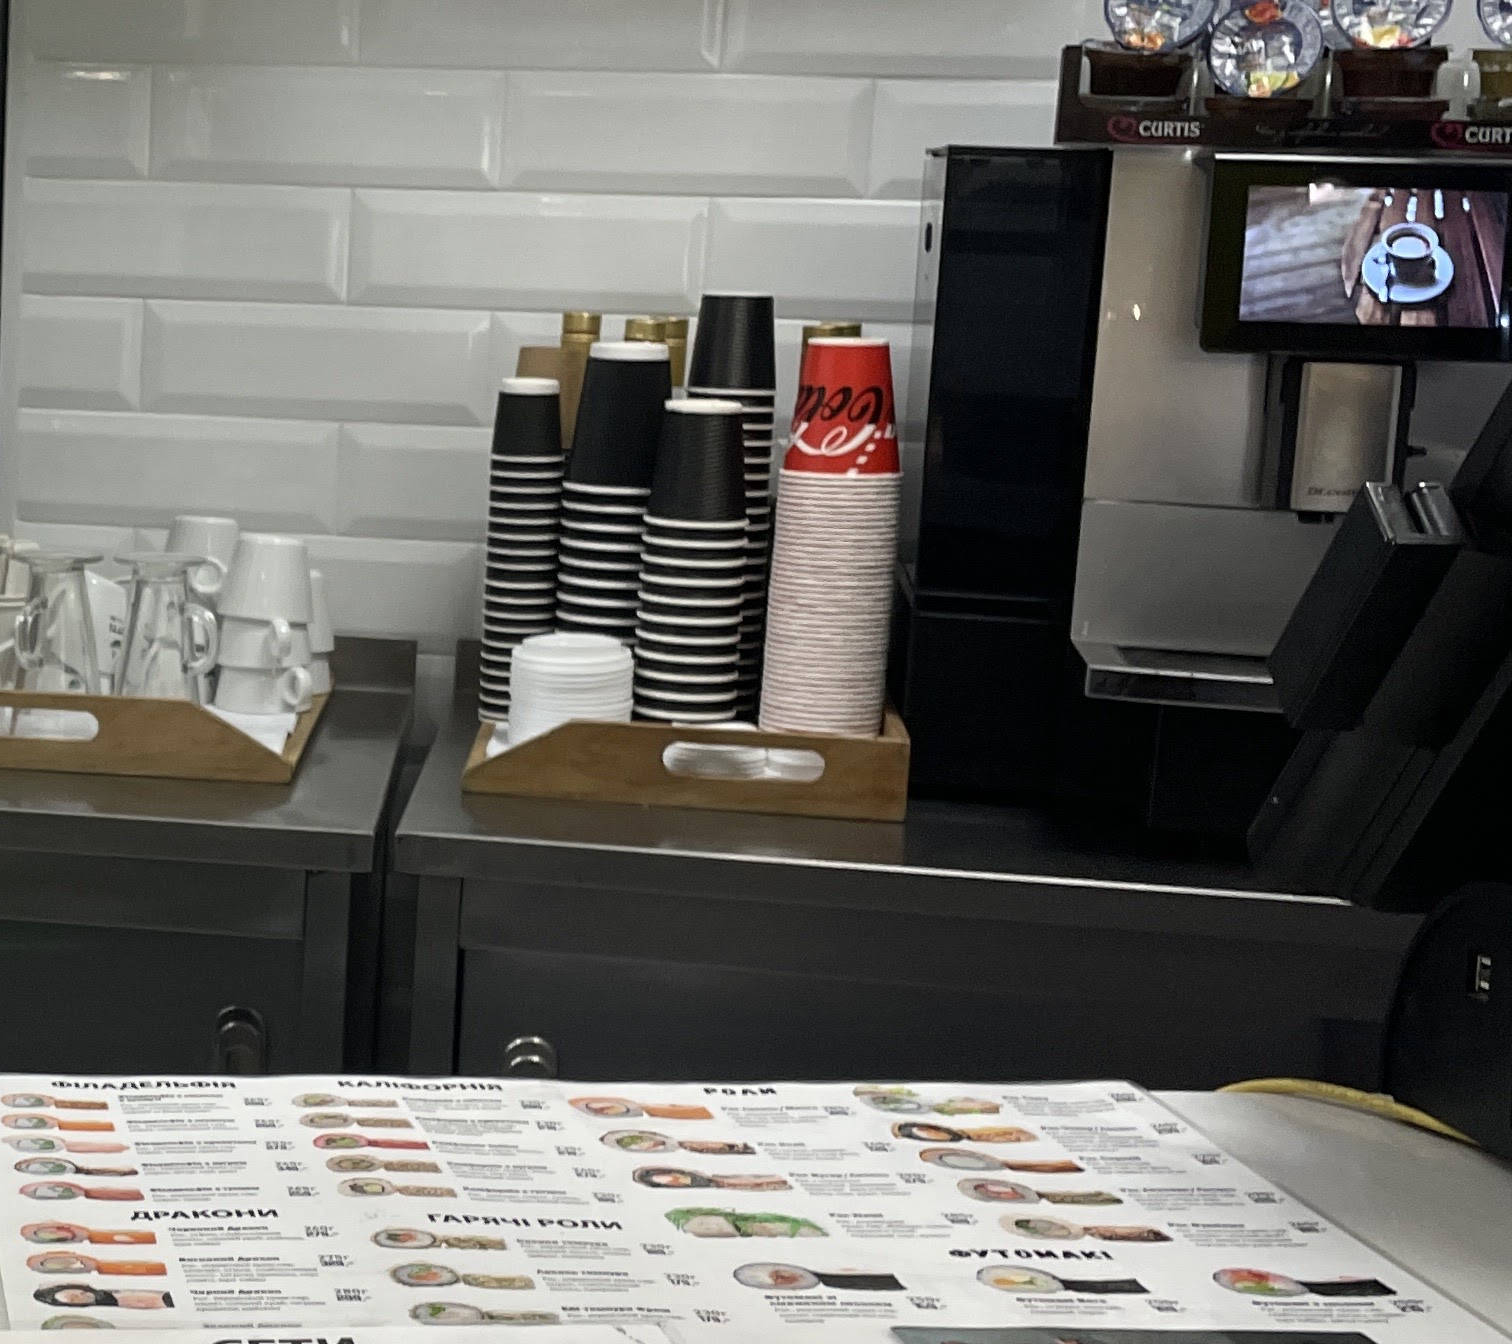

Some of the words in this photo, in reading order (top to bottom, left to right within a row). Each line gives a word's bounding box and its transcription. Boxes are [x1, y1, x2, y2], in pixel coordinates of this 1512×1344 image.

[1139, 121, 1201, 138] CURTIS
[51, 1080, 237, 1091] ФІЛАДЕЛЬФІЯ
[337, 1080, 503, 1092] КАЛІФОРНІЯ
[130, 1208, 279, 1221] ДРАКОНИ
[426, 1212, 531, 1227] ГАРЯЧІ
[538, 1218, 623, 1230] РОЛИ
[948, 1248, 1114, 1260] ФУТОМАКІ
